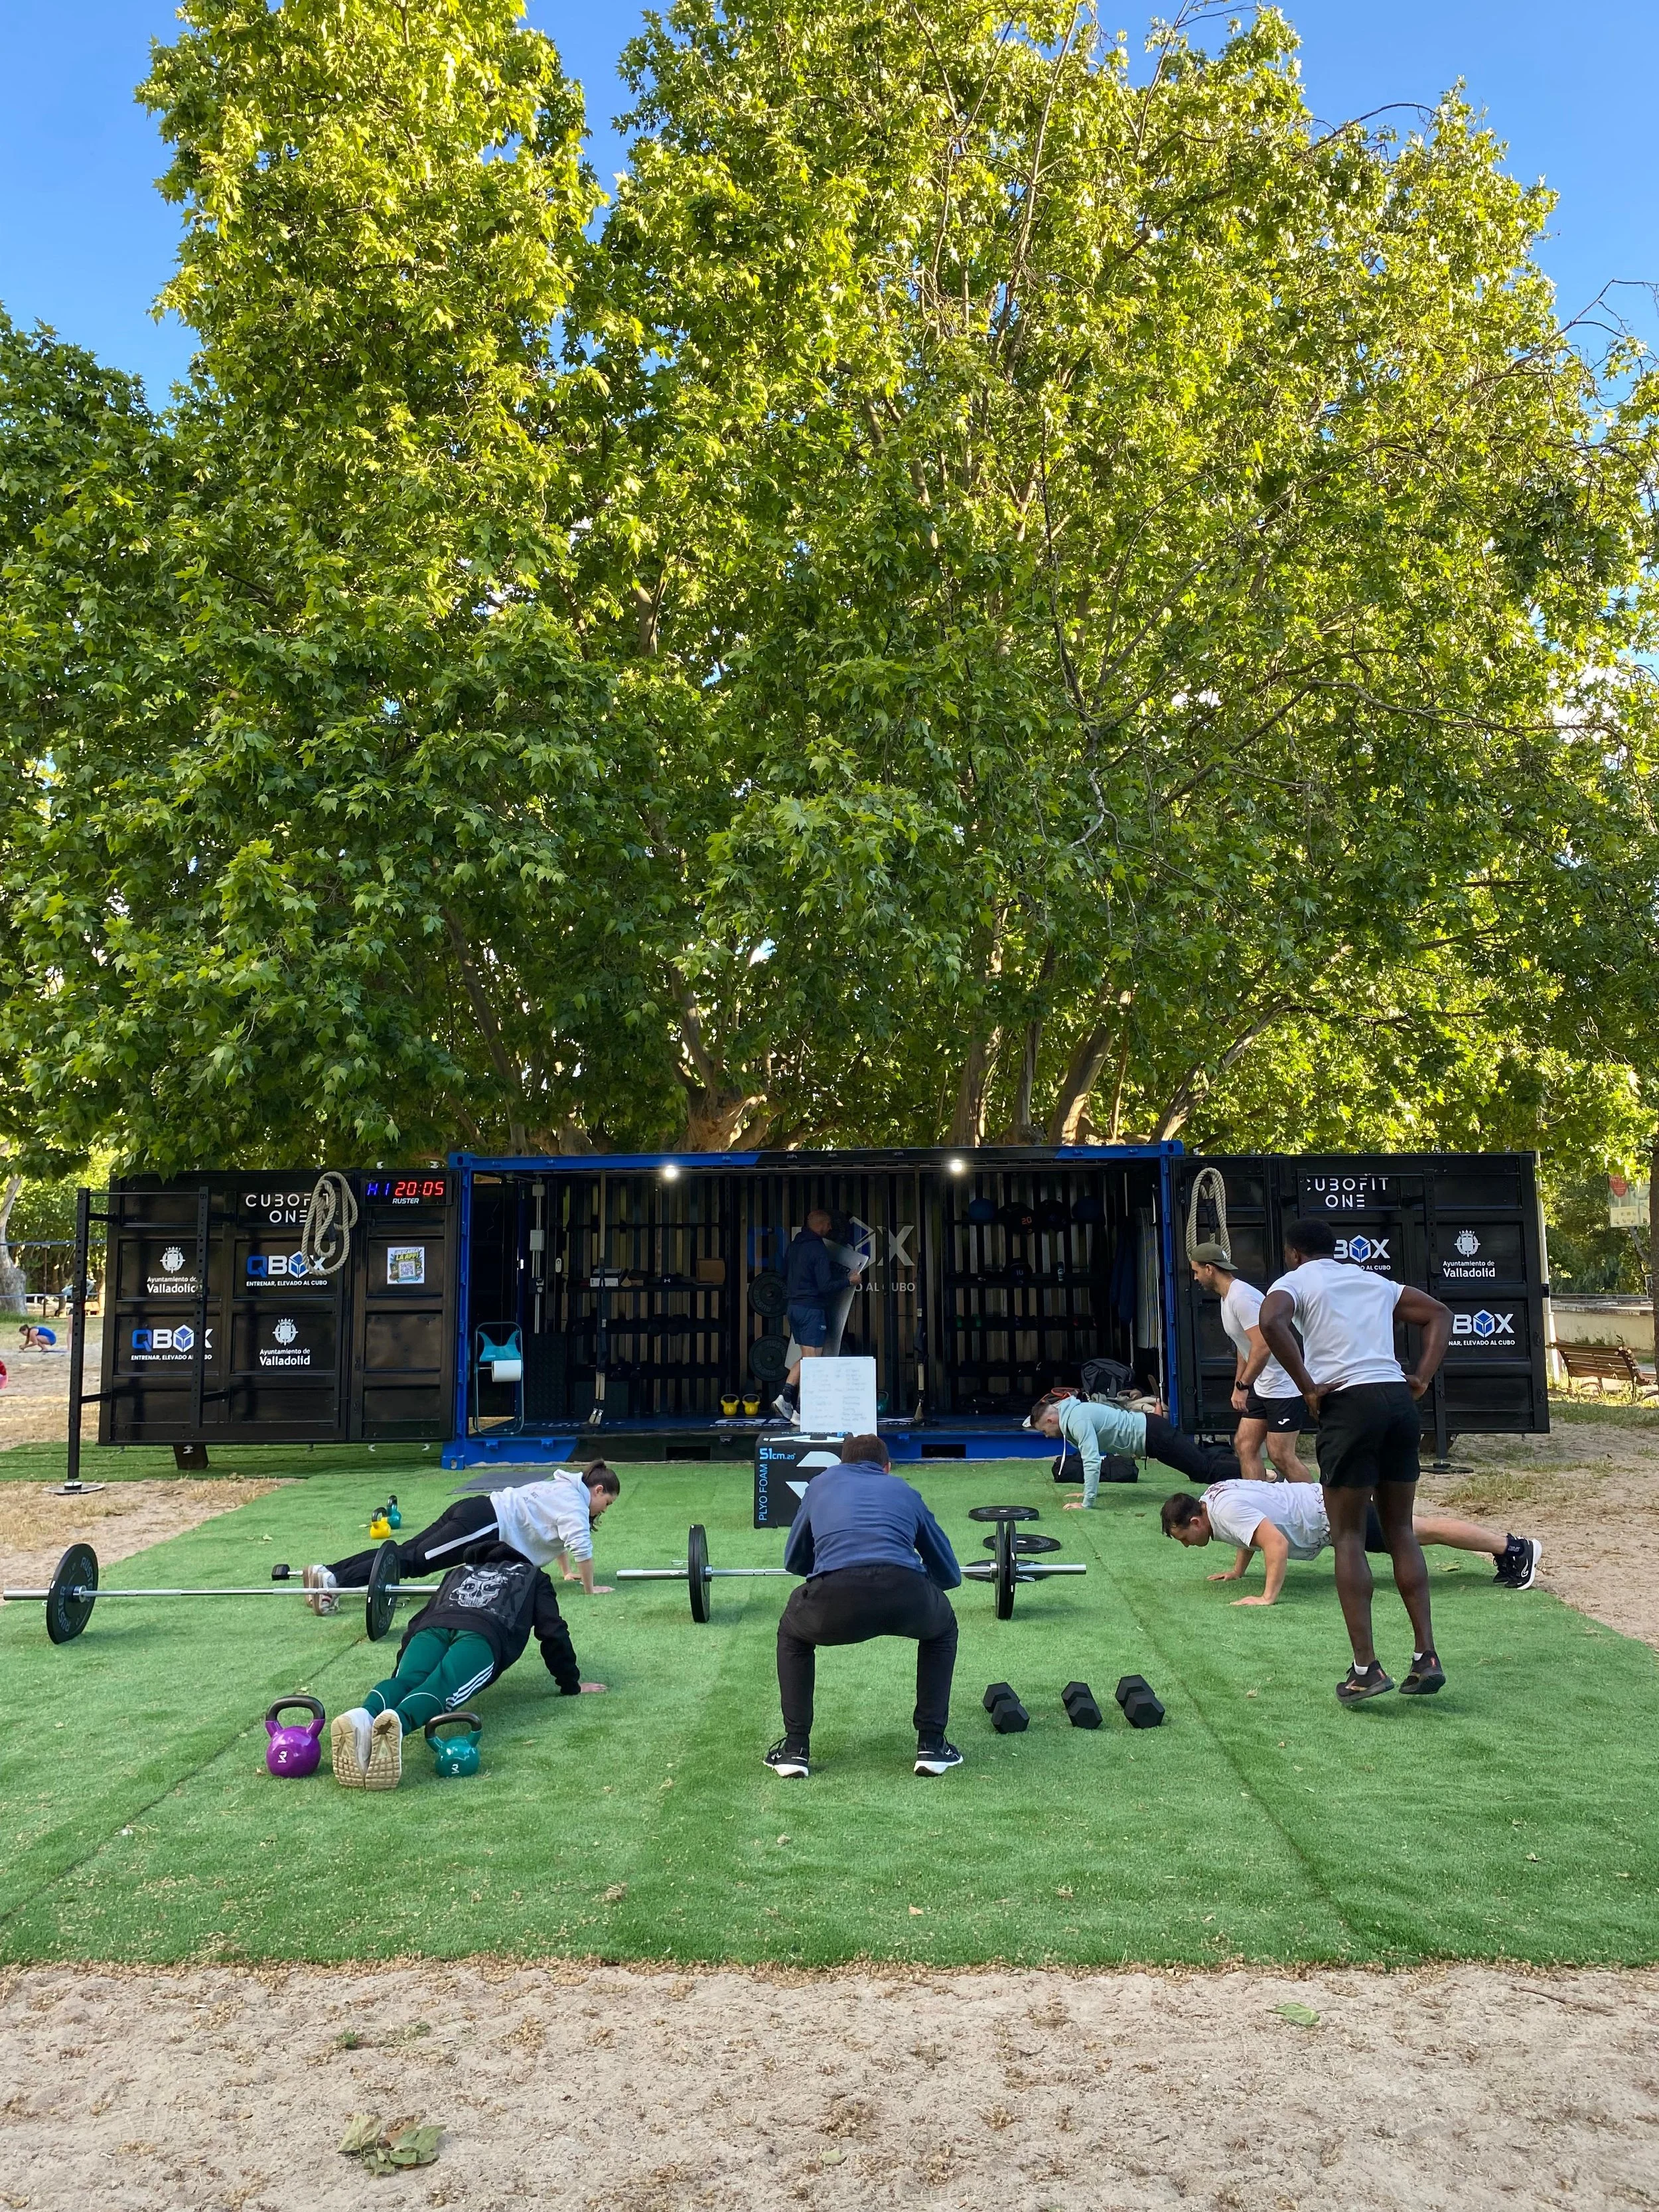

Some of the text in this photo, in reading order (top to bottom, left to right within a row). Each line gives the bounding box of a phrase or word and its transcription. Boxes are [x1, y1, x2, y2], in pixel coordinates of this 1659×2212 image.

[395, 1182, 444, 1195] 20:05
[246, 1193, 328, 1207] CUBOFT
[1325, 1195, 1365, 1207] ONE
[269, 1210, 307, 1223] ONE
[1443, 1267, 1496, 1278] Valladolid
[866, 1283, 880, 1291] AL
[883, 1282, 916, 1291] UBO
[259, 1355, 311, 1366] Valladolid
[759, 1464, 768, 1520] PLYO FOAM
